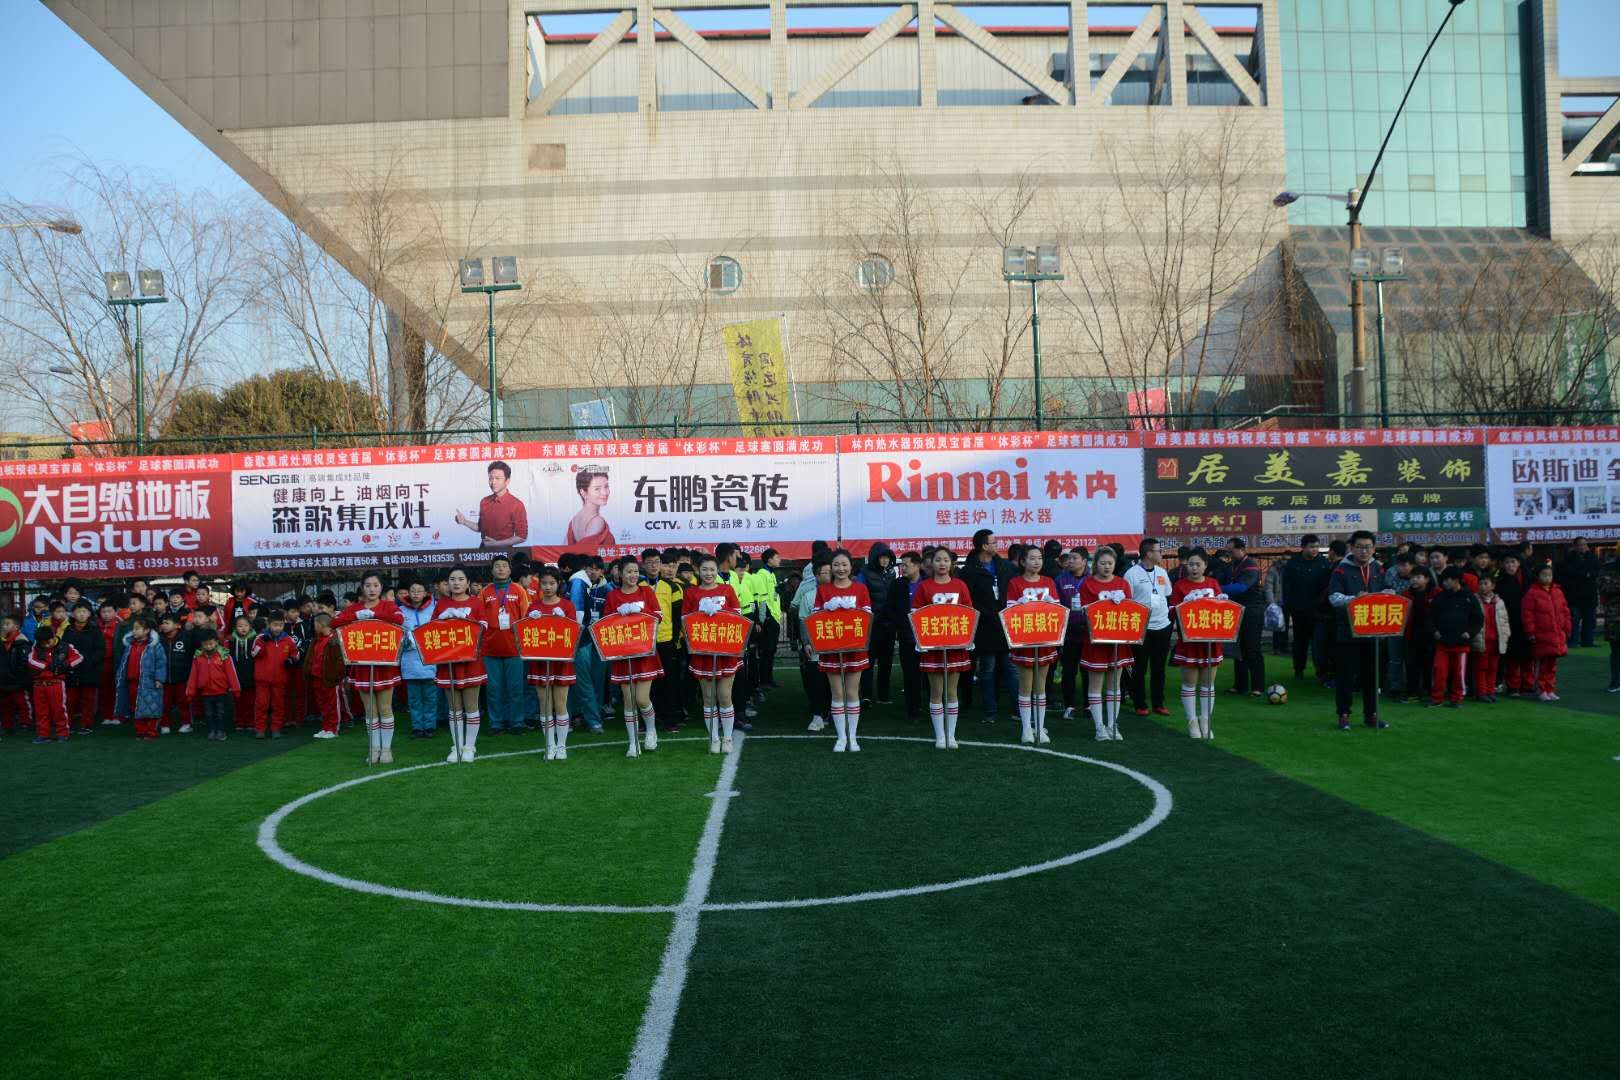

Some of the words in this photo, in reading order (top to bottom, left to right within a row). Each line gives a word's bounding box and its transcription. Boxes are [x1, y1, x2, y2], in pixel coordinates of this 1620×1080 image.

[866, 457, 1031, 503] Rinnai
[1045, 470, 1117, 499] 林内
[24, 479, 211, 525] 大自然地板
[273, 485, 345, 504] 健康向上
[356, 483, 430, 500] 油烟向下
[633, 473, 789, 513] 东鹏瓷砖
[1188, 493, 1441, 508] 整体家居服务品牌
[272, 501, 431, 534] 森歌集成灶
[936, 509, 988, 525] 壁挂炉
[1001, 508, 1052, 524] 热水器
[1161, 514, 1247, 527] 荣华木门
[1280, 512, 1362, 524] 北台壁纸
[34, 524, 201, 555] Nature
[816, 616, 863, 641] 灵宝市一高
[921, 615, 970, 636] 灵宝开拓者
[1011, 612, 1059, 635] 中原银行
[1094, 610, 1141, 632] 九班传奇
[348, 629, 397, 651] 实验二中三队
[424, 625, 473, 650] 实验二中二队
[523, 626, 572, 648] 实验二中一队
[600, 621, 649, 646] 实验高中二队
